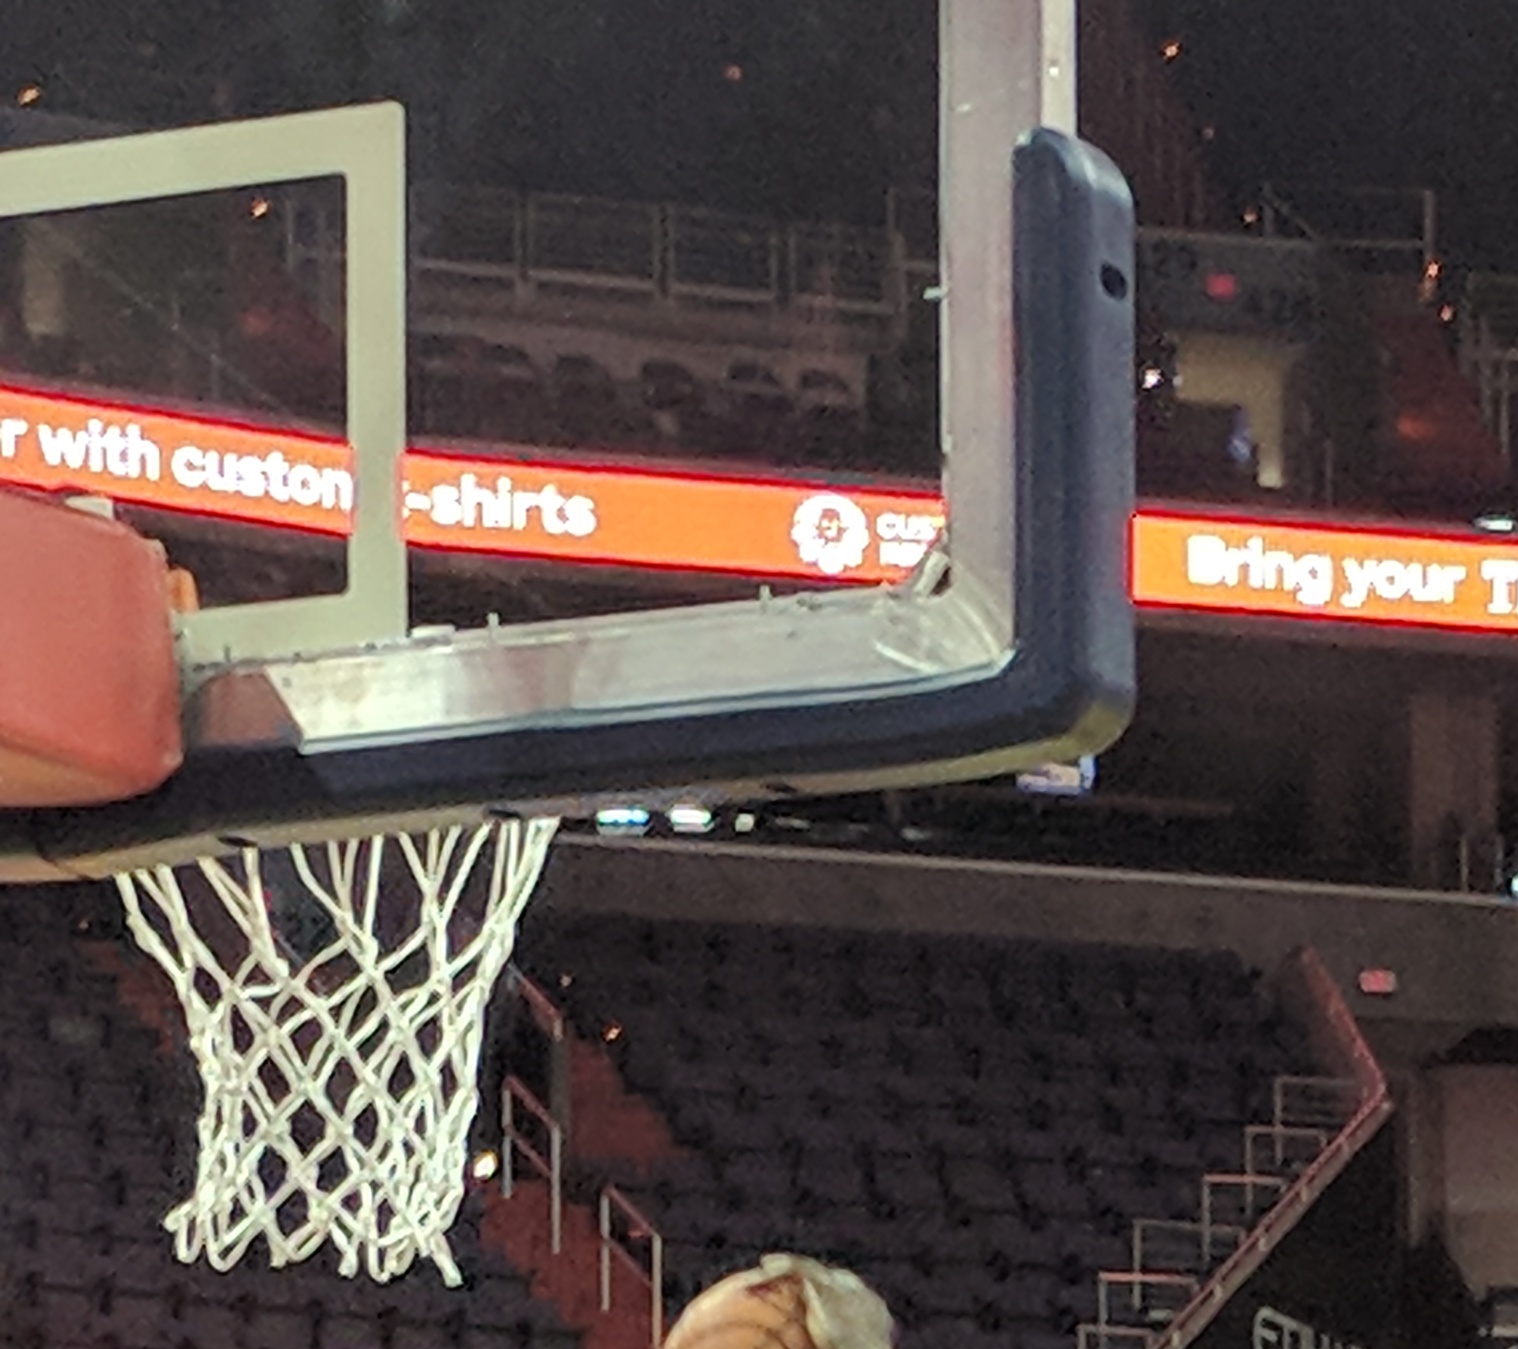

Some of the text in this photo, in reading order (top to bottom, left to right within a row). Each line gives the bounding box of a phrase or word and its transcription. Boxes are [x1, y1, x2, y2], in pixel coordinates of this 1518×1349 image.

[38, 418, 160, 480] with
[402, 473, 598, 537] -shirts
[1187, 534, 1333, 606] Bring
[1341, 555, 1466, 608] your
